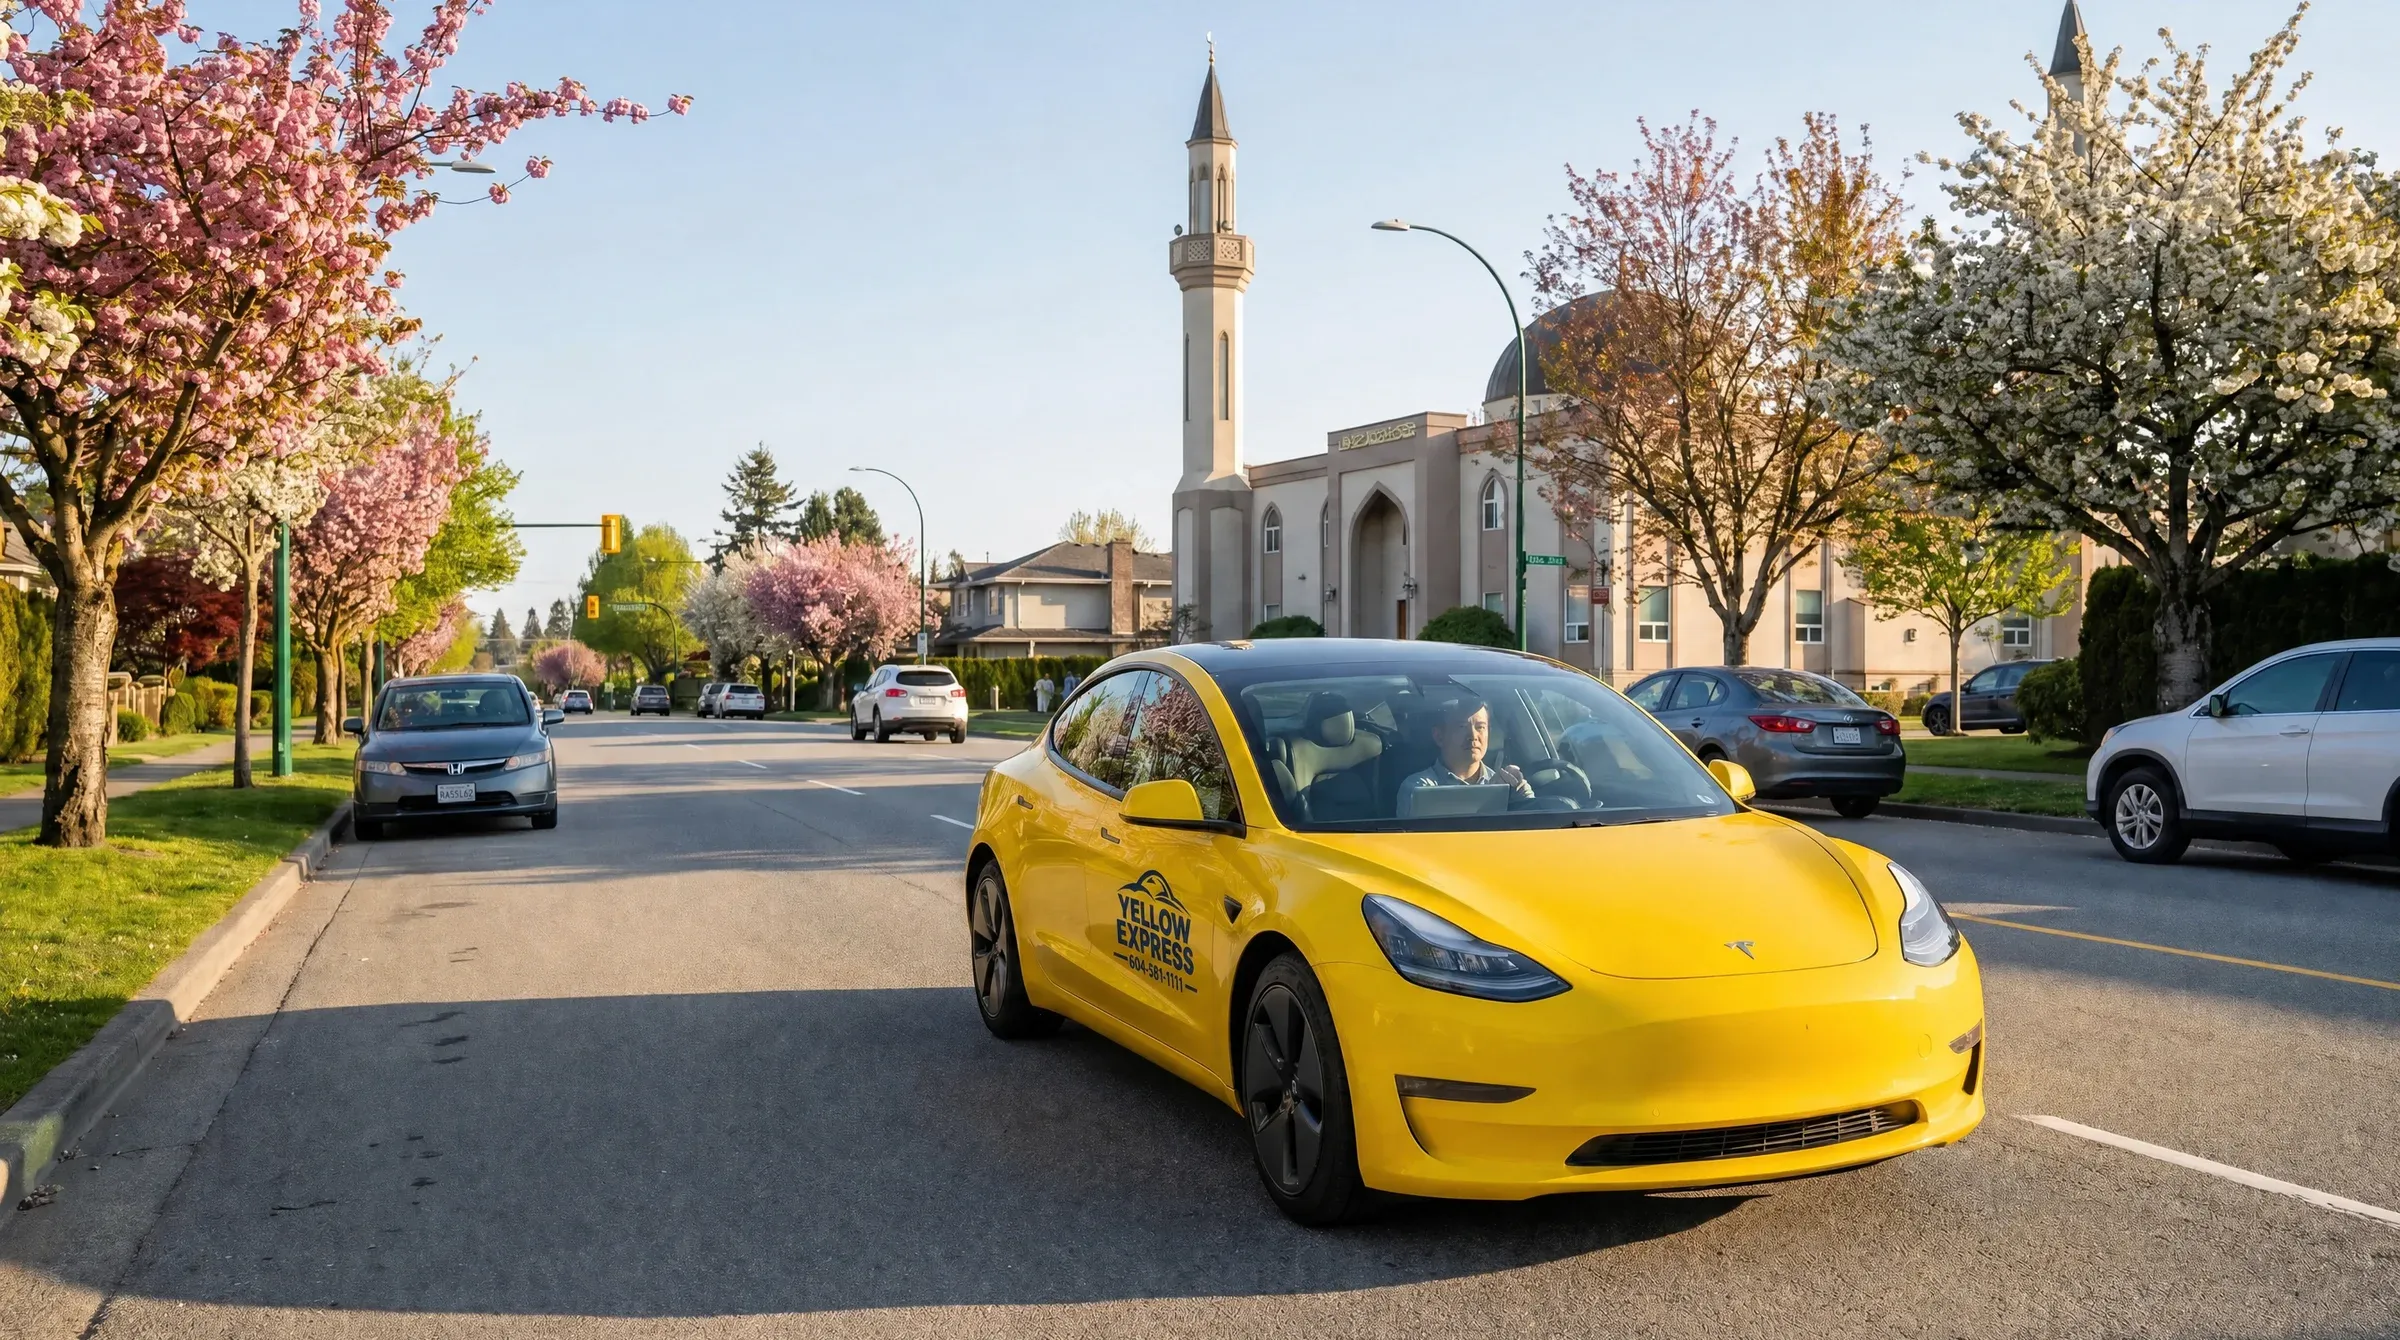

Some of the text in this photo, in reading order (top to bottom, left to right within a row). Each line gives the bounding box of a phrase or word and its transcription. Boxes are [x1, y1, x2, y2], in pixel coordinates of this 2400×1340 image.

[1118, 894, 1191, 943] YELLOW
[1117, 919, 1194, 975] EXPRESS
[1129, 955, 1183, 992] 604-581-1111
